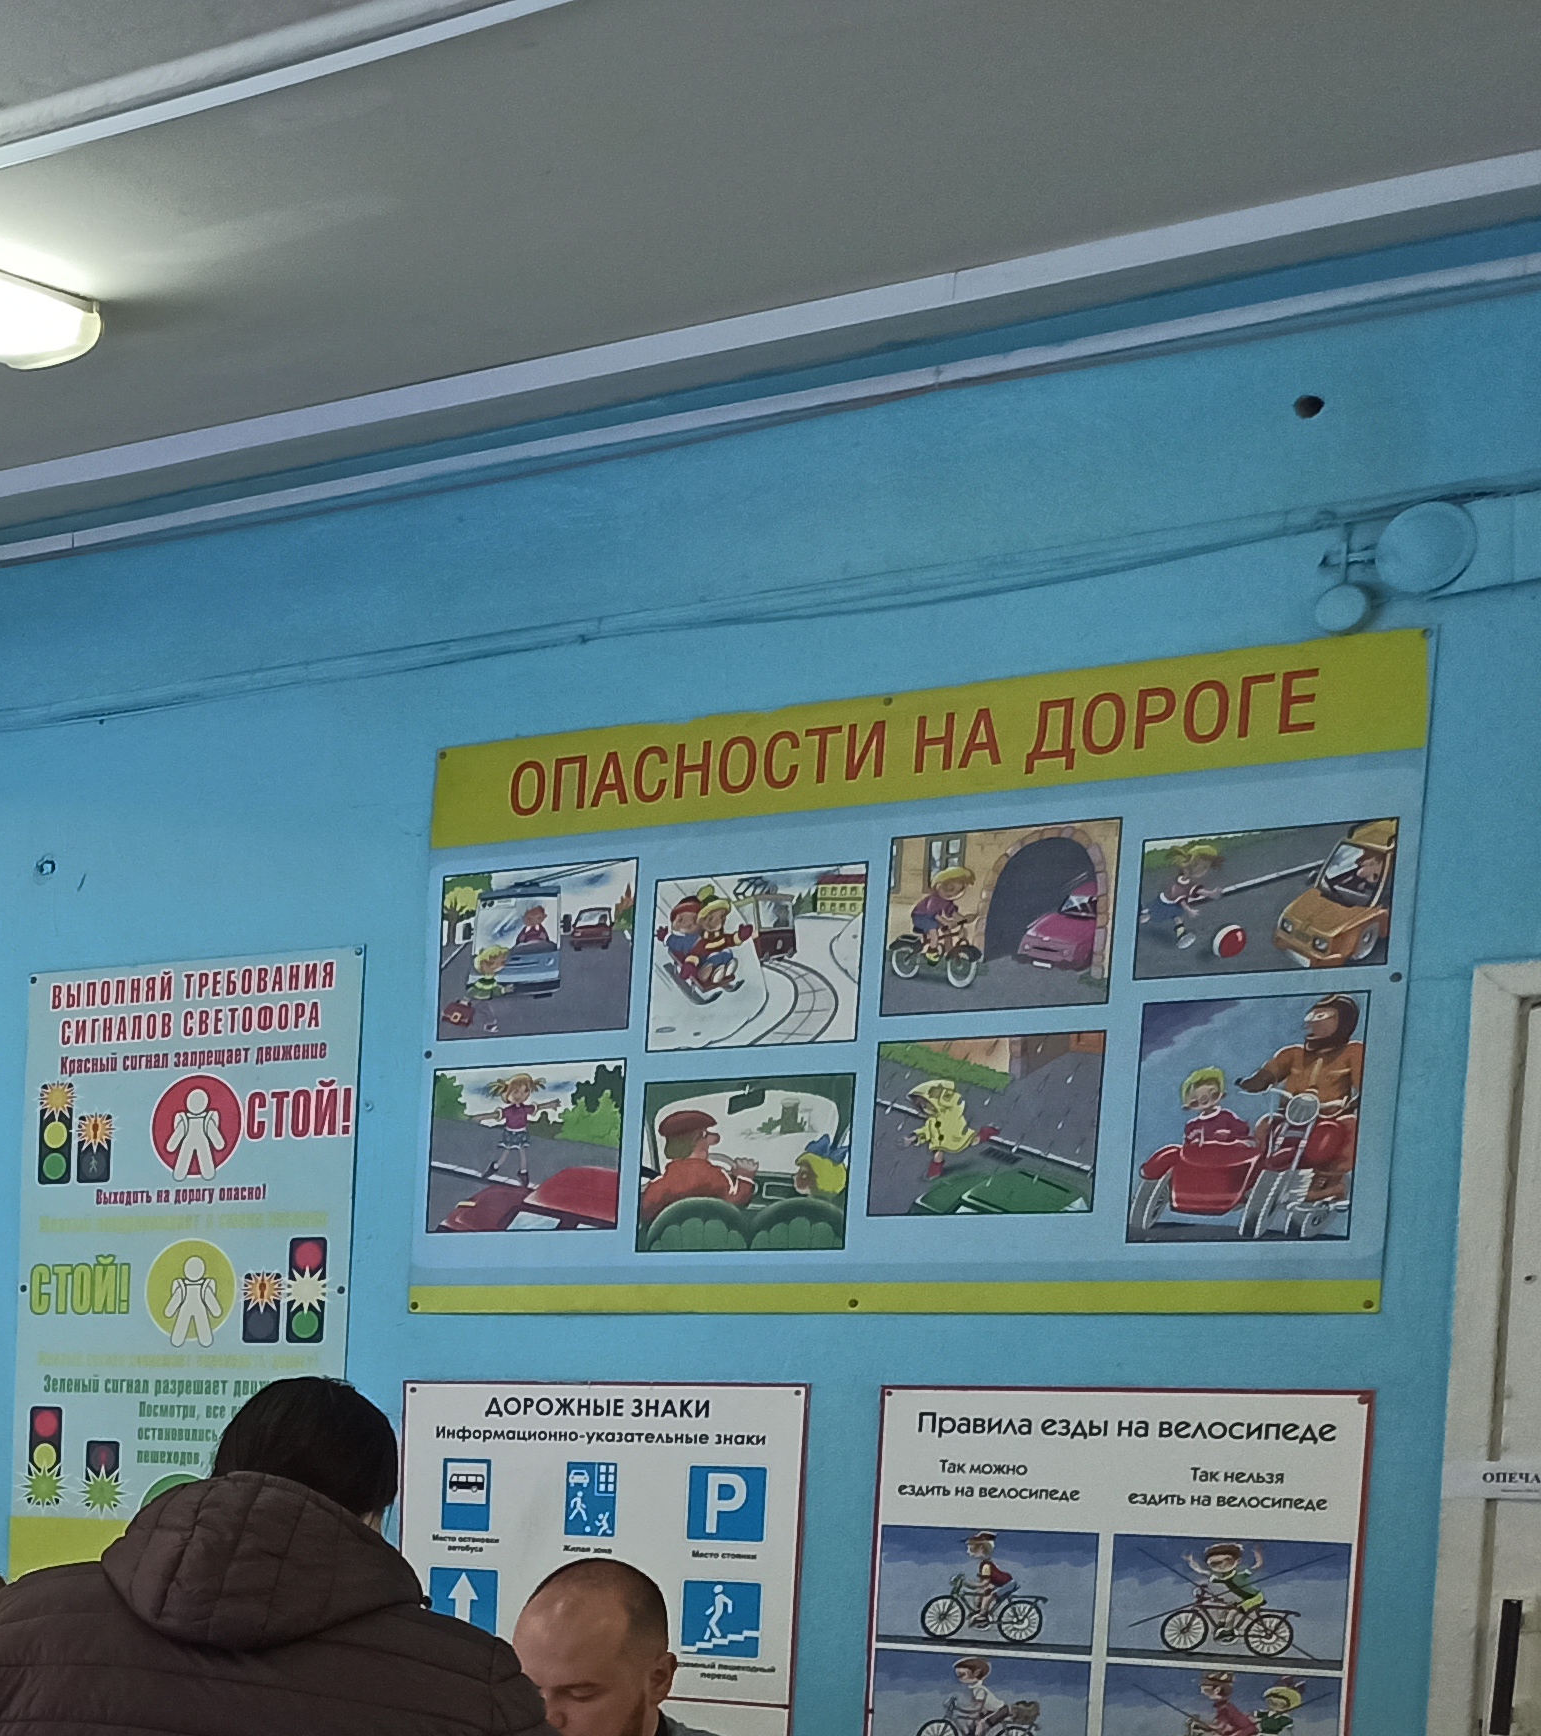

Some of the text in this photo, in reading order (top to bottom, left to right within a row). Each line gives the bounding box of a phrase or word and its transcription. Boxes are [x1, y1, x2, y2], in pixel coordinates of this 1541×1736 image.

[508, 667, 1321, 817] ОПАСНОСТИ НА ДОРОГЕ
[51, 961, 336, 1010] ВЫПОЛНЯЙ ТРЕБОВАНИЯ
[60, 1002, 321, 1046] СИГНАЛОВ СВЕТОФОРА
[60, 1042, 328, 1077] Красный сигнал запрещает движение
[245, 1078, 353, 1140] СТОЙ!
[96, 1183, 267, 1206] Выходить на дорогу опасно!
[30, 1254, 131, 1315] СТОЙ!
[43, 1373, 100, 1393] Зеленый
[104, 1378, 150, 1394] сигнал
[154, 1378, 229, 1398] разрешает
[139, 1401, 200, 1421] Посмотри,
[205, 1405, 226, 1419] все
[484, 1396, 711, 1418] ДОРОЖНЫЕ ЗНАКИ
[435, 1425, 767, 1447] Информационно-указательные знаки
[917, 1411, 1337, 1444] Правила езды на велосипеде
[939, 1458, 1028, 1477] Так можно
[1190, 1467, 1285, 1485] Так нельзя
[1482, 1472, 1541, 1485] ОПЕЧА
[705, 1472, 747, 1534] P
[897, 1483, 1080, 1502] ездить на велосипеде
[1128, 1490, 1328, 1512] ездить на велосипеде
